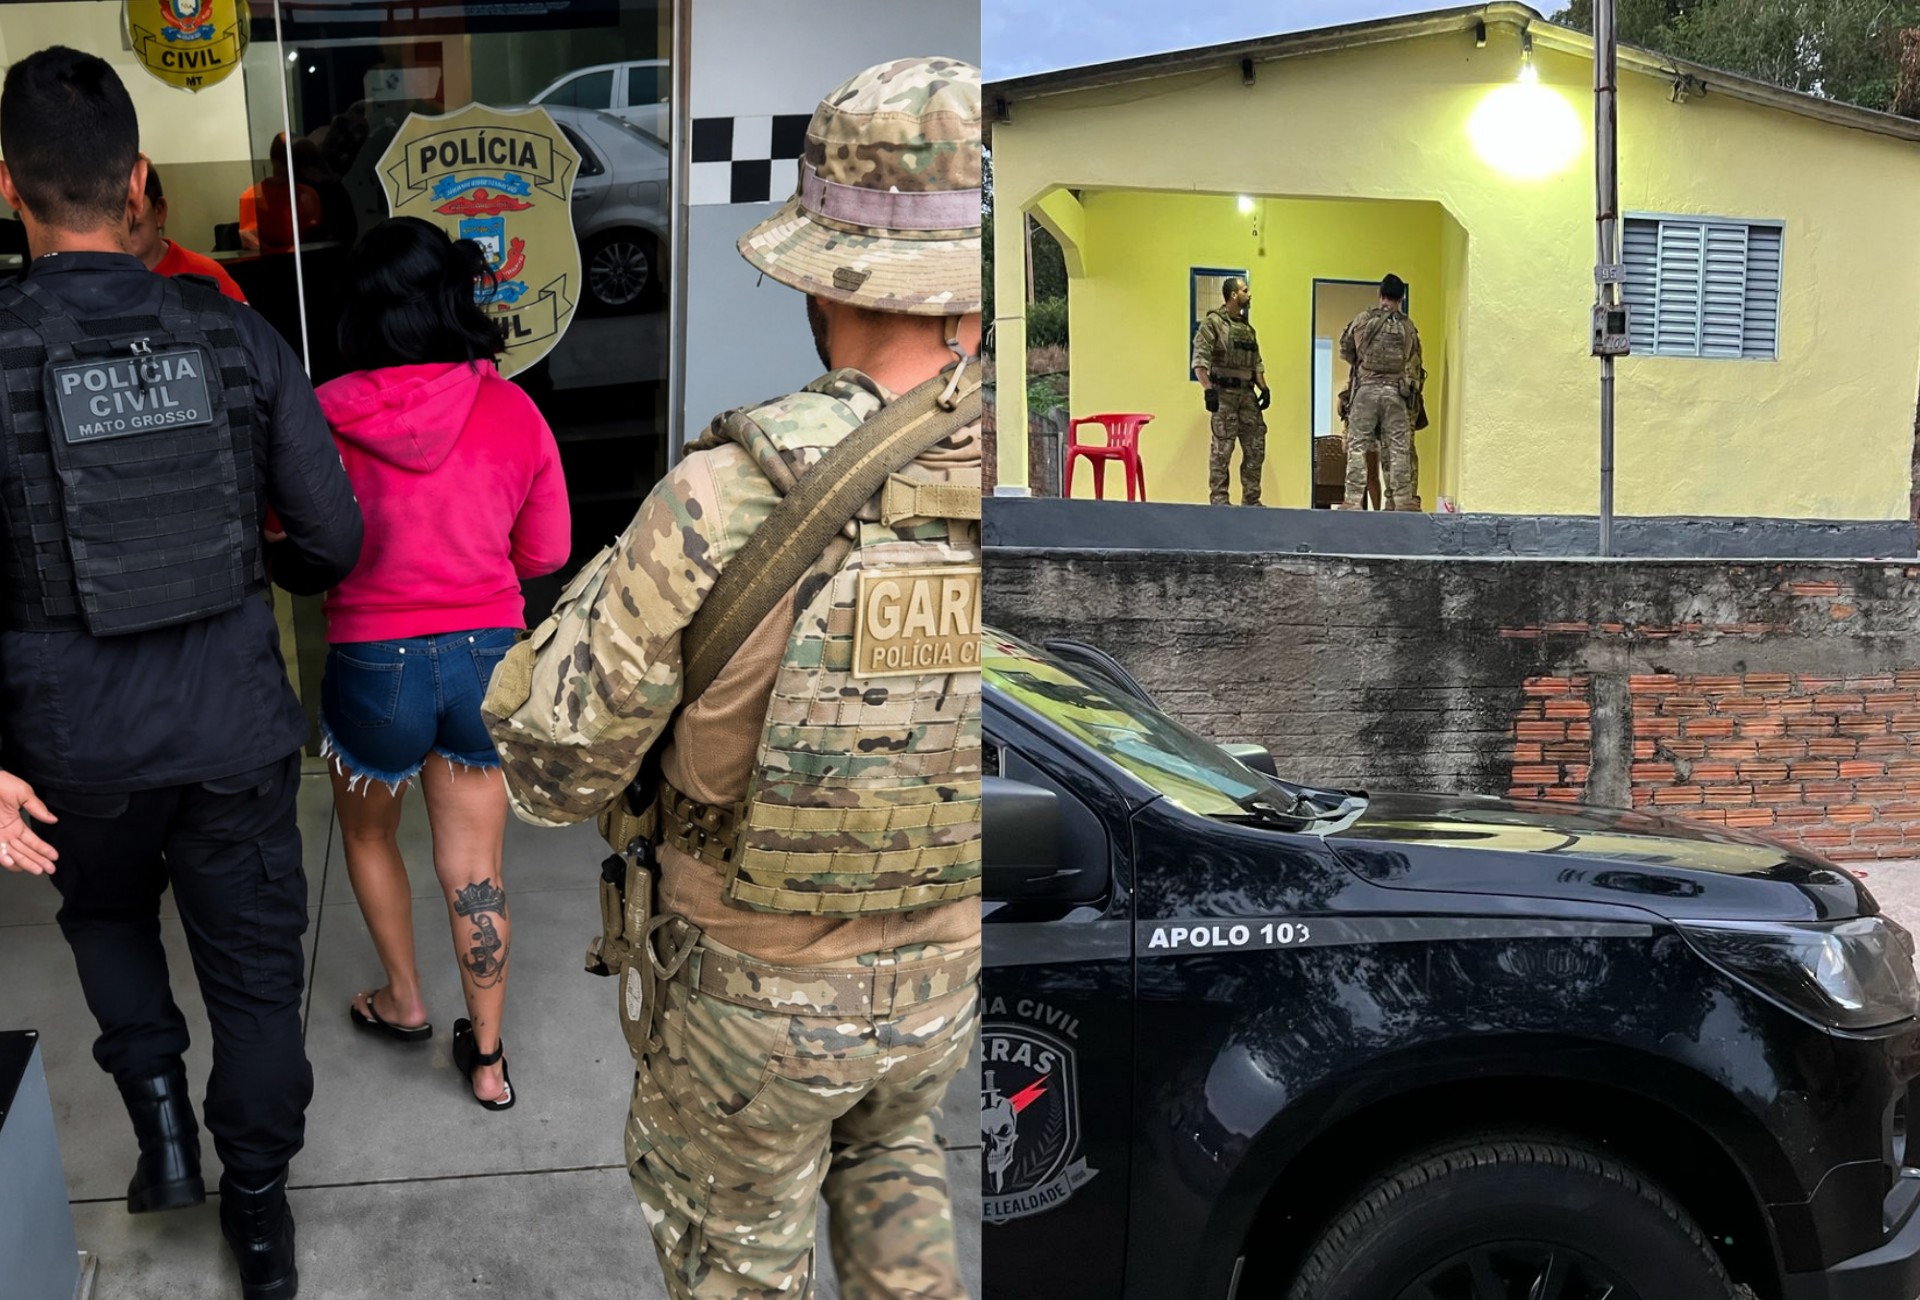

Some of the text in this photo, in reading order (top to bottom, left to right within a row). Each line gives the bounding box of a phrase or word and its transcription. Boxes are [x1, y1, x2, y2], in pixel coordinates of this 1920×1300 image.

[161, 48, 221, 68] CIVIL
[185, 76, 203, 87] MT
[420, 130, 538, 174] POLÍCIA
[89, 386, 179, 417] CIVIL
[79, 408, 198, 436] MATO GROSSO
[872, 638, 953, 669] POLÍCIA
[1148, 924, 1250, 948] APOLO
[1016, 998, 1080, 1040] CIVIL
[983, 1183, 1066, 1216] E LEALDADE
